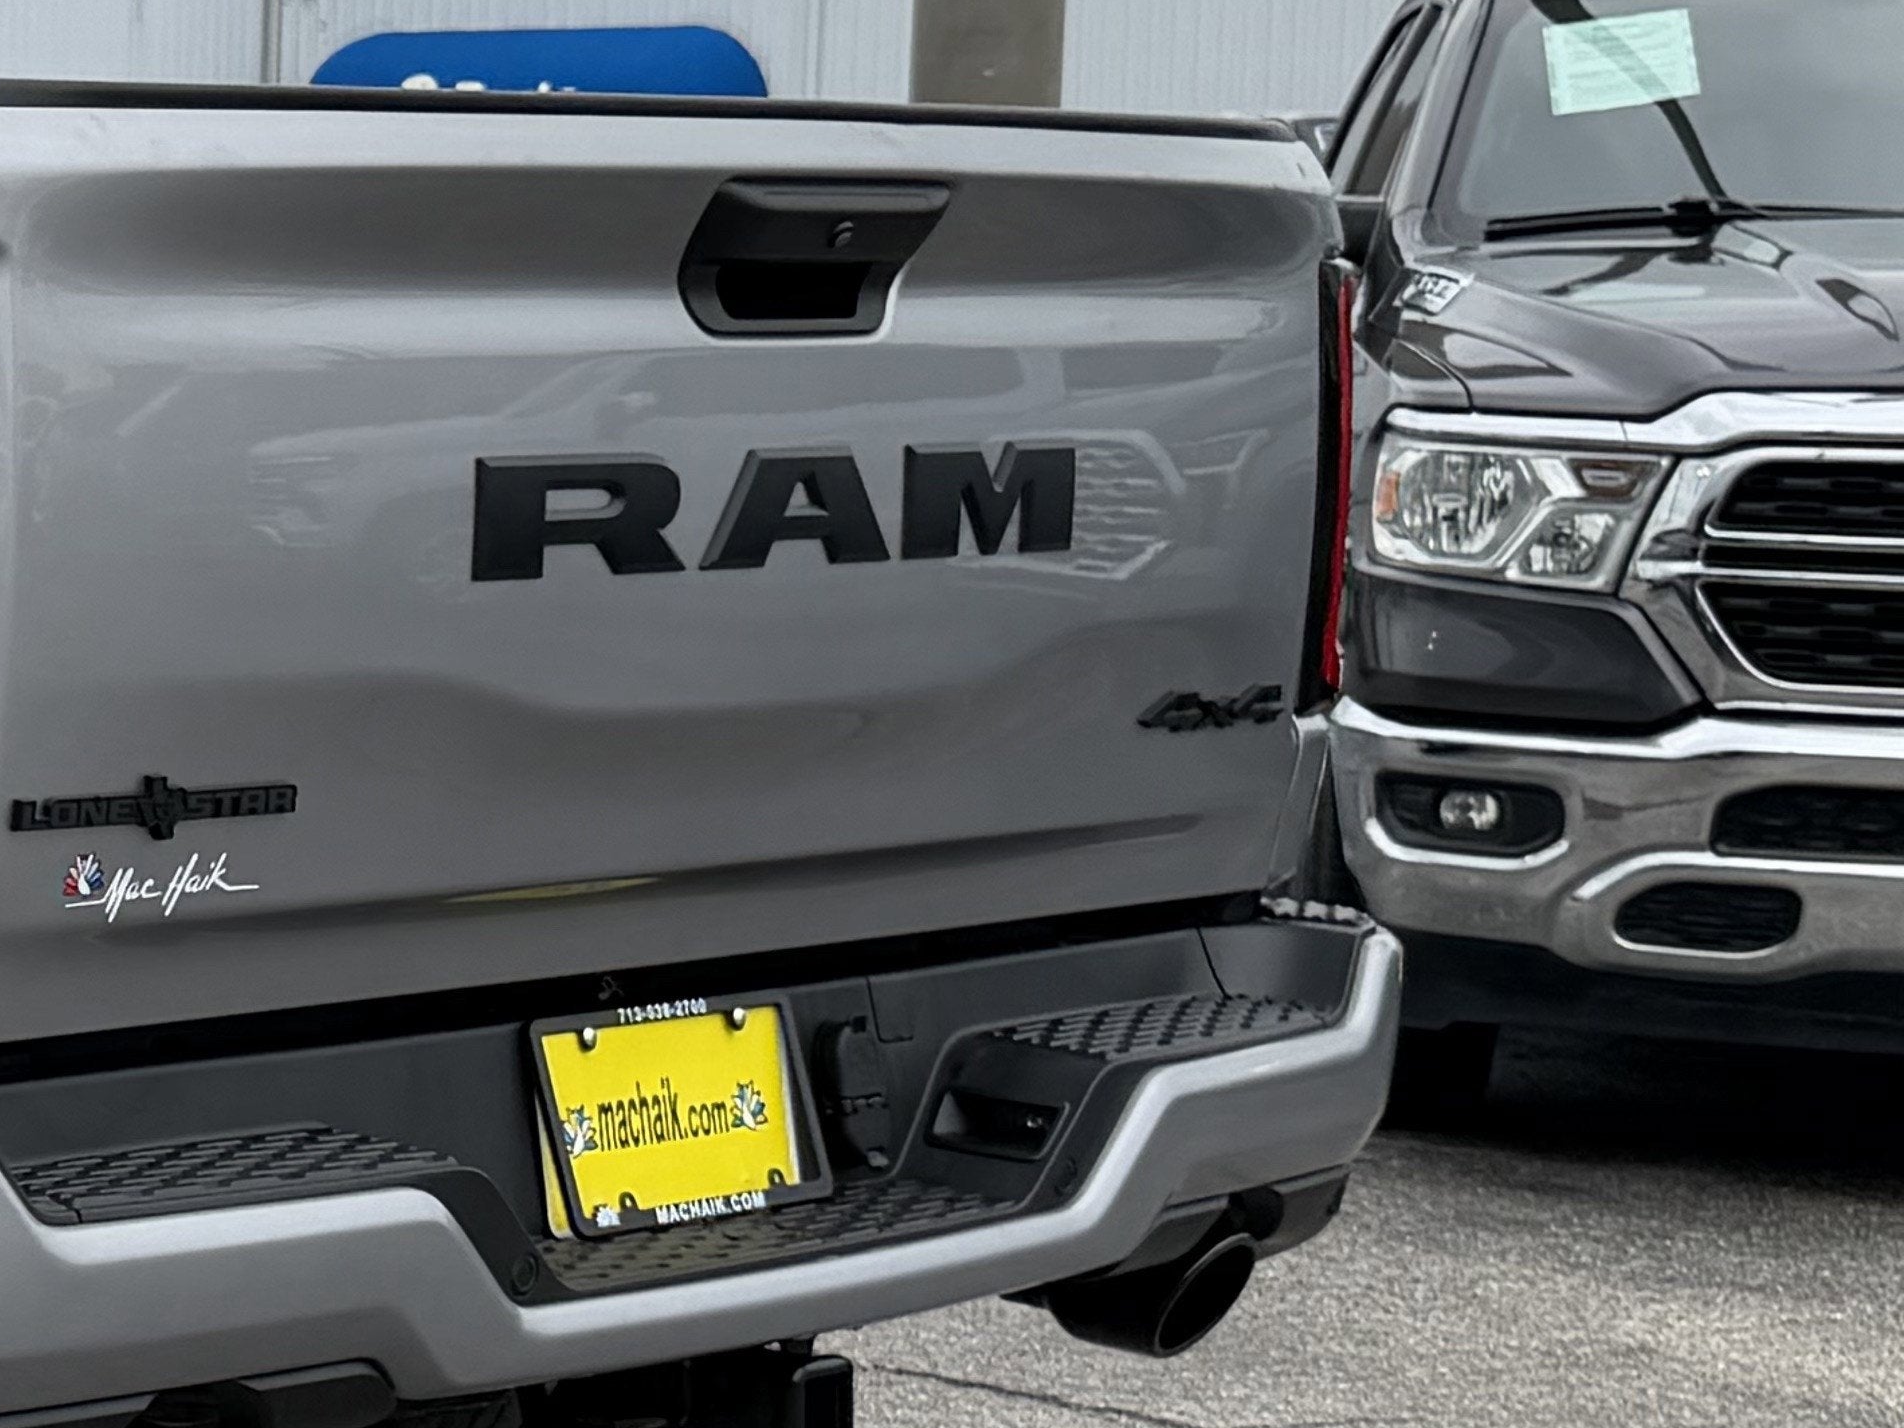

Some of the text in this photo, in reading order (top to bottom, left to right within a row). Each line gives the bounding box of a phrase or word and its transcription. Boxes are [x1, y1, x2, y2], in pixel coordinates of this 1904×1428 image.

[471, 439, 1076, 582] RAM
[9, 784, 297, 832] LONE STAR
[65, 852, 260, 923] Mac Haik
[597, 1076, 731, 1153] machaik.com
[655, 1191, 768, 1225] MACHAIK.COM
